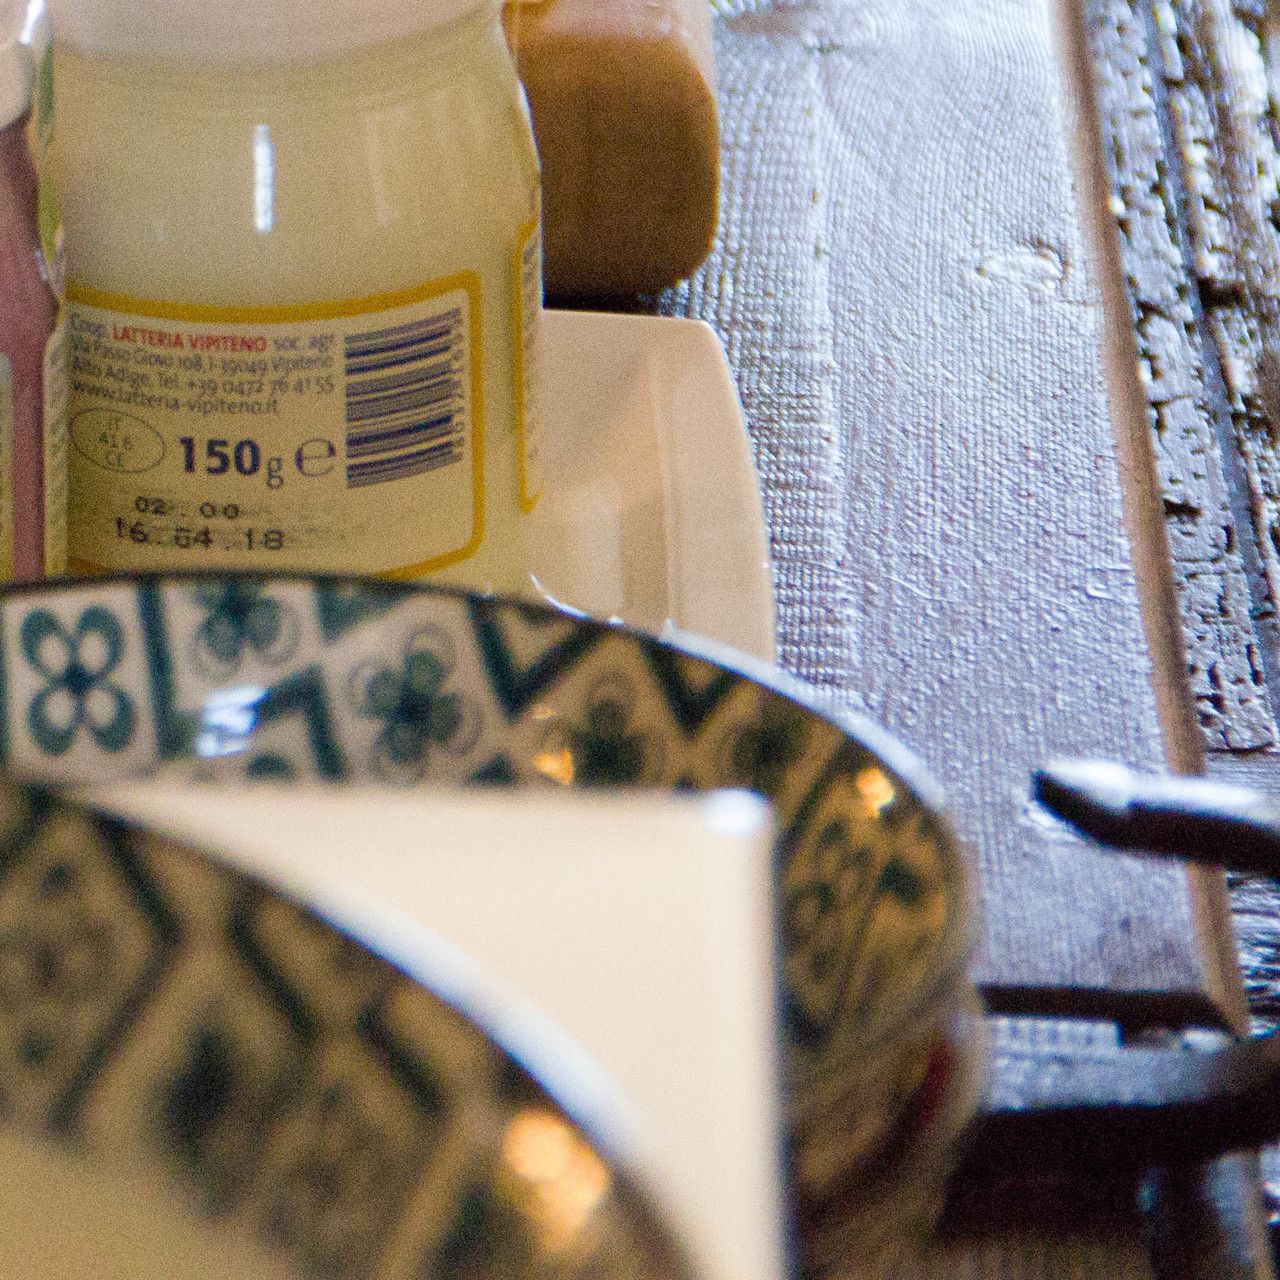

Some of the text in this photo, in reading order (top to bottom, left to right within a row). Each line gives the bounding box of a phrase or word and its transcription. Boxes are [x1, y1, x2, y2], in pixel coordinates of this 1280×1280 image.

[112, 325, 184, 351] LATTERIA
[188, 334, 268, 353] VIPITENO
[271, 354, 334, 376] Vipiteno
[222, 379, 263, 398] 0472
[270, 378, 289, 398] 76
[293, 378, 312, 396] 41
[316, 376, 336, 395] 55
